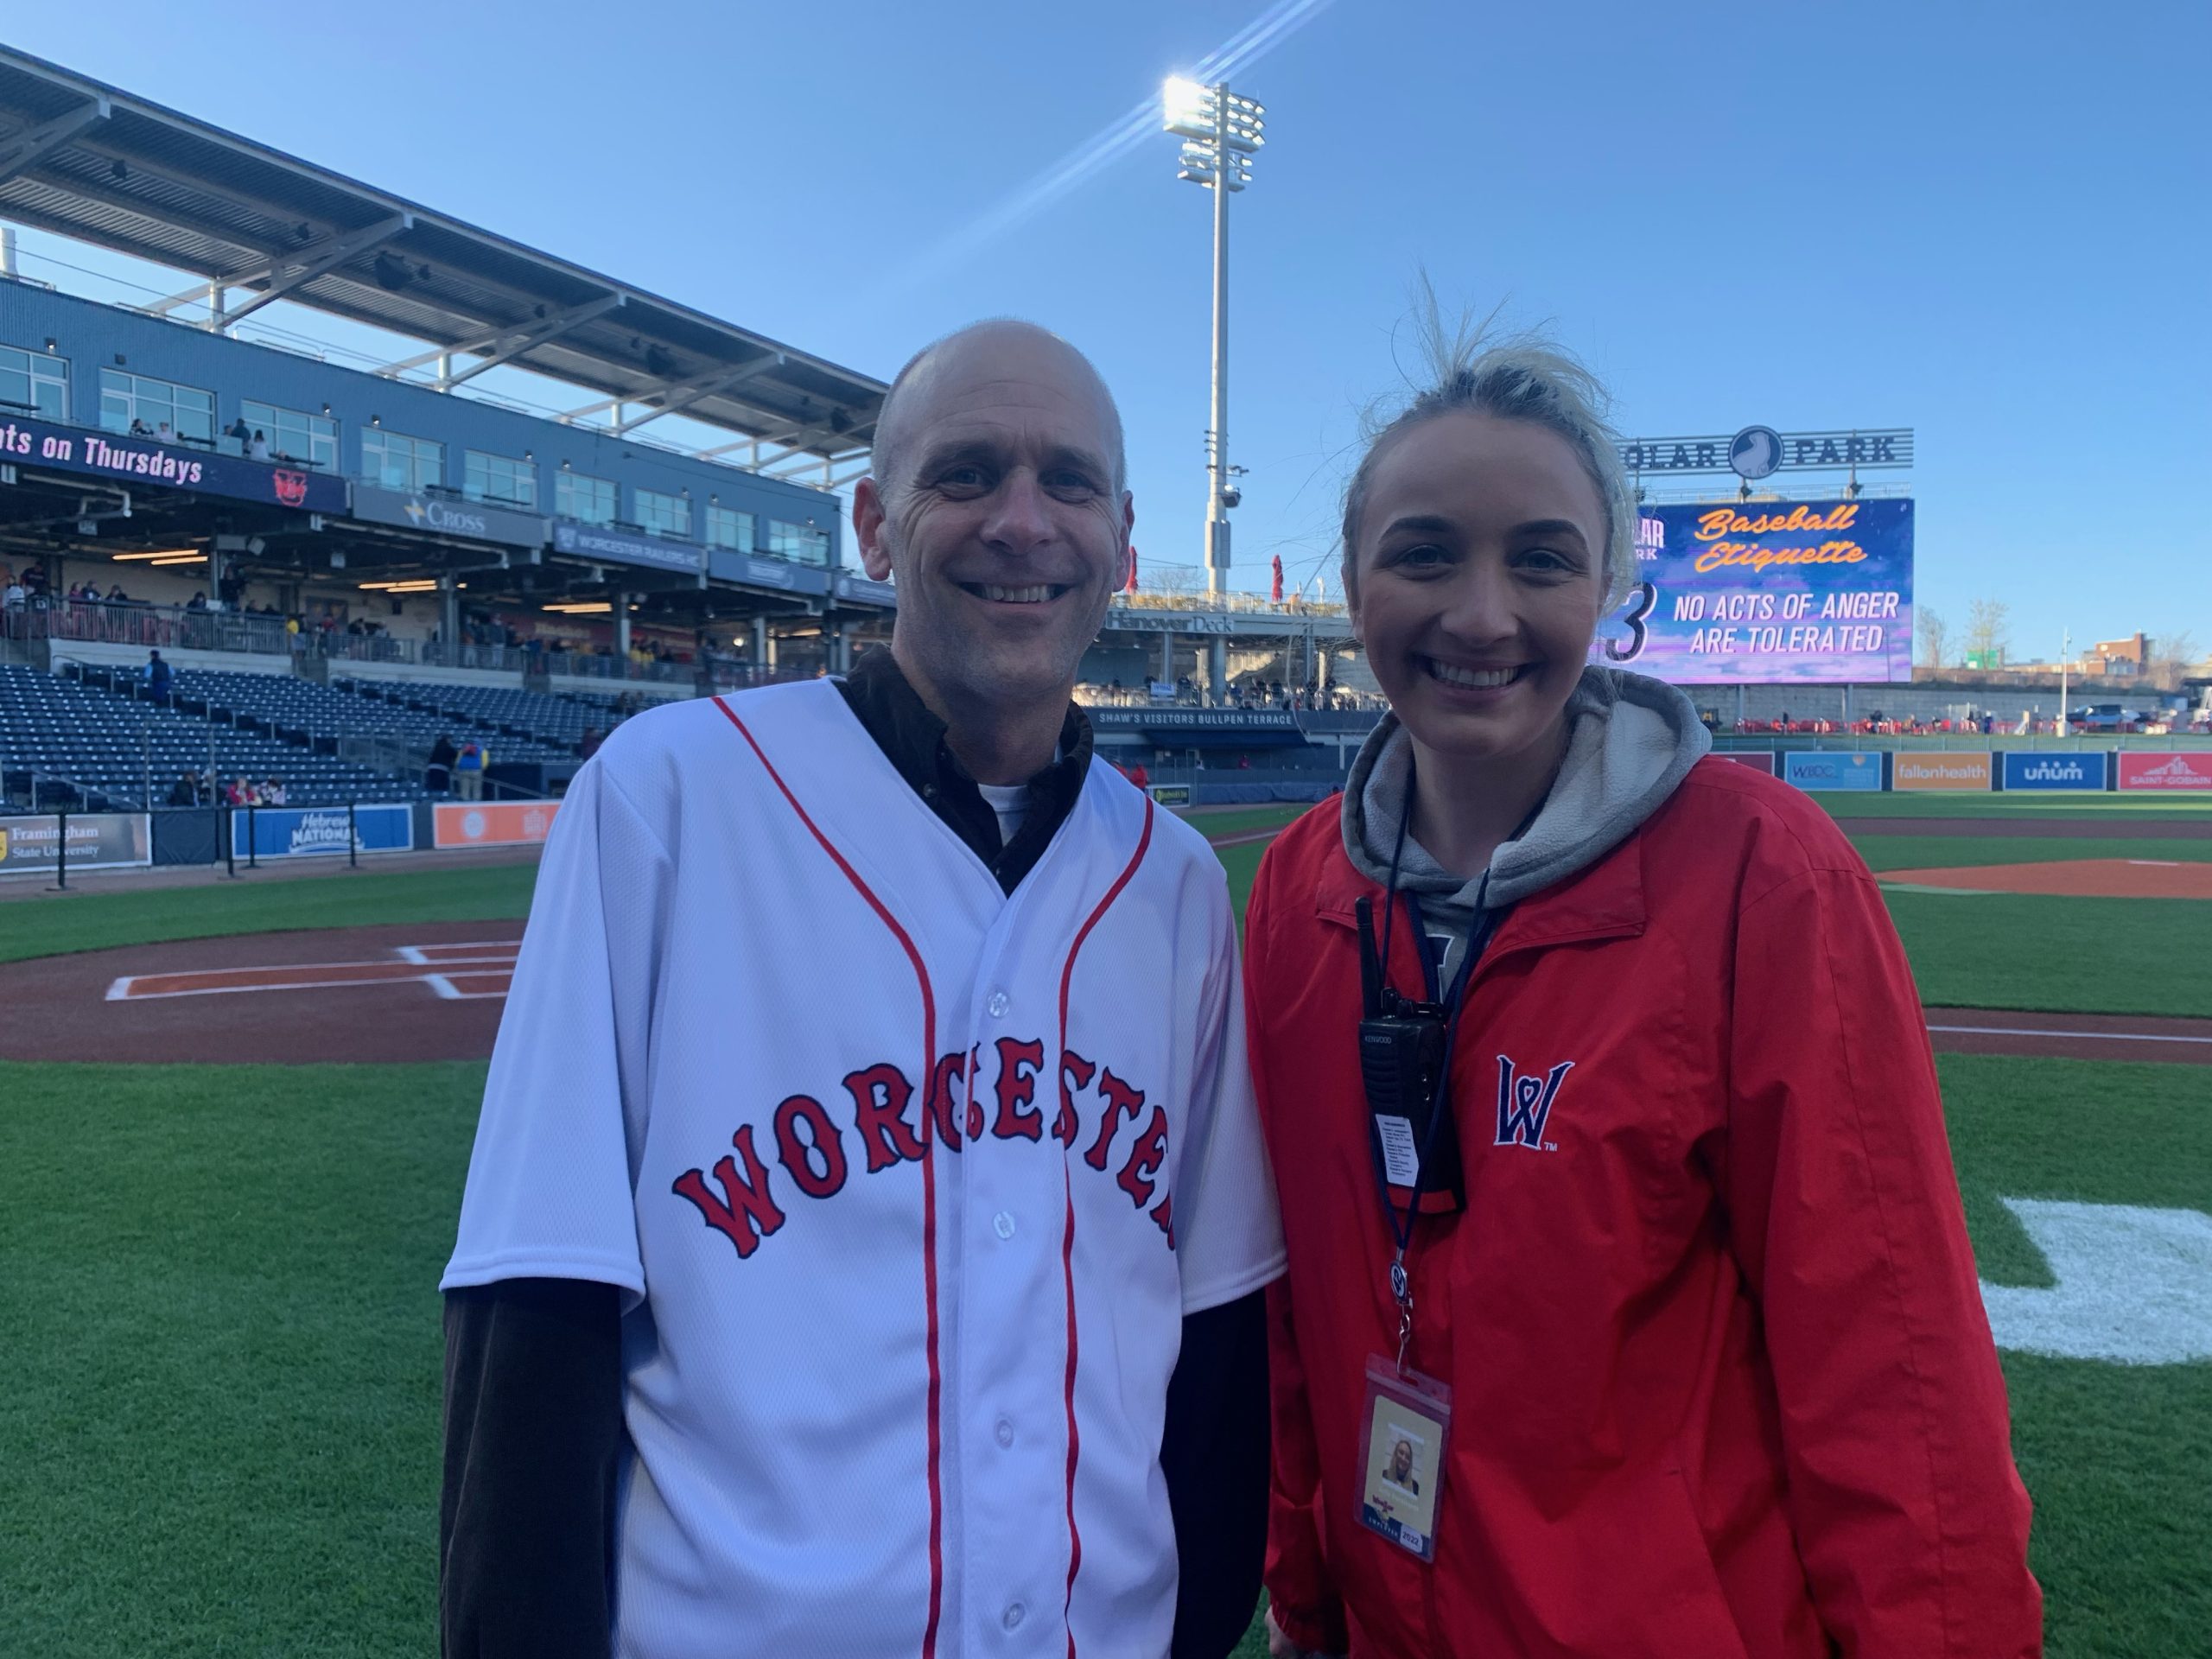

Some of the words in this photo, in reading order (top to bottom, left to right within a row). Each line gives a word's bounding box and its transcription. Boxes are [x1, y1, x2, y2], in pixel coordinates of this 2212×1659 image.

[43, 435, 72, 460] on
[85, 437, 202, 485] Thursdays
[1624, 442, 1716, 469] OLAR
[1796, 436, 1897, 464] PARK
[1694, 505, 1859, 541] Baseball
[1695, 540, 1867, 573] Etiquette
[1674, 595, 1706, 621] NO
[1713, 594, 1777, 620] ACTS
[1783, 593, 1814, 620] OF
[1821, 592, 1899, 619] ANGER
[1107, 611, 1192, 630] Hanover
[1192, 615, 1233, 632] Deck
[1606, 582, 1658, 663] 3
[1690, 628, 1738, 653] ARE
[1748, 626, 1884, 653] TOLERATED
[1099, 713, 1140, 724] SHAW'S
[1144, 714, 1194, 724] VISITORS
[1198, 714, 1244, 725] BULLPEN
[1247, 715, 1292, 725] TERRACE
[1899, 764, 1986, 779] fallonhealth
[2129, 776, 2211, 785] SAINT-GOBAIN
[302, 812, 351, 829] Hebrew
[12, 846, 41, 858] State
[43, 844, 99, 858] Unversity
[1493, 1054, 1575, 1150] W
[1402, 1531, 1420, 1546] 2022
